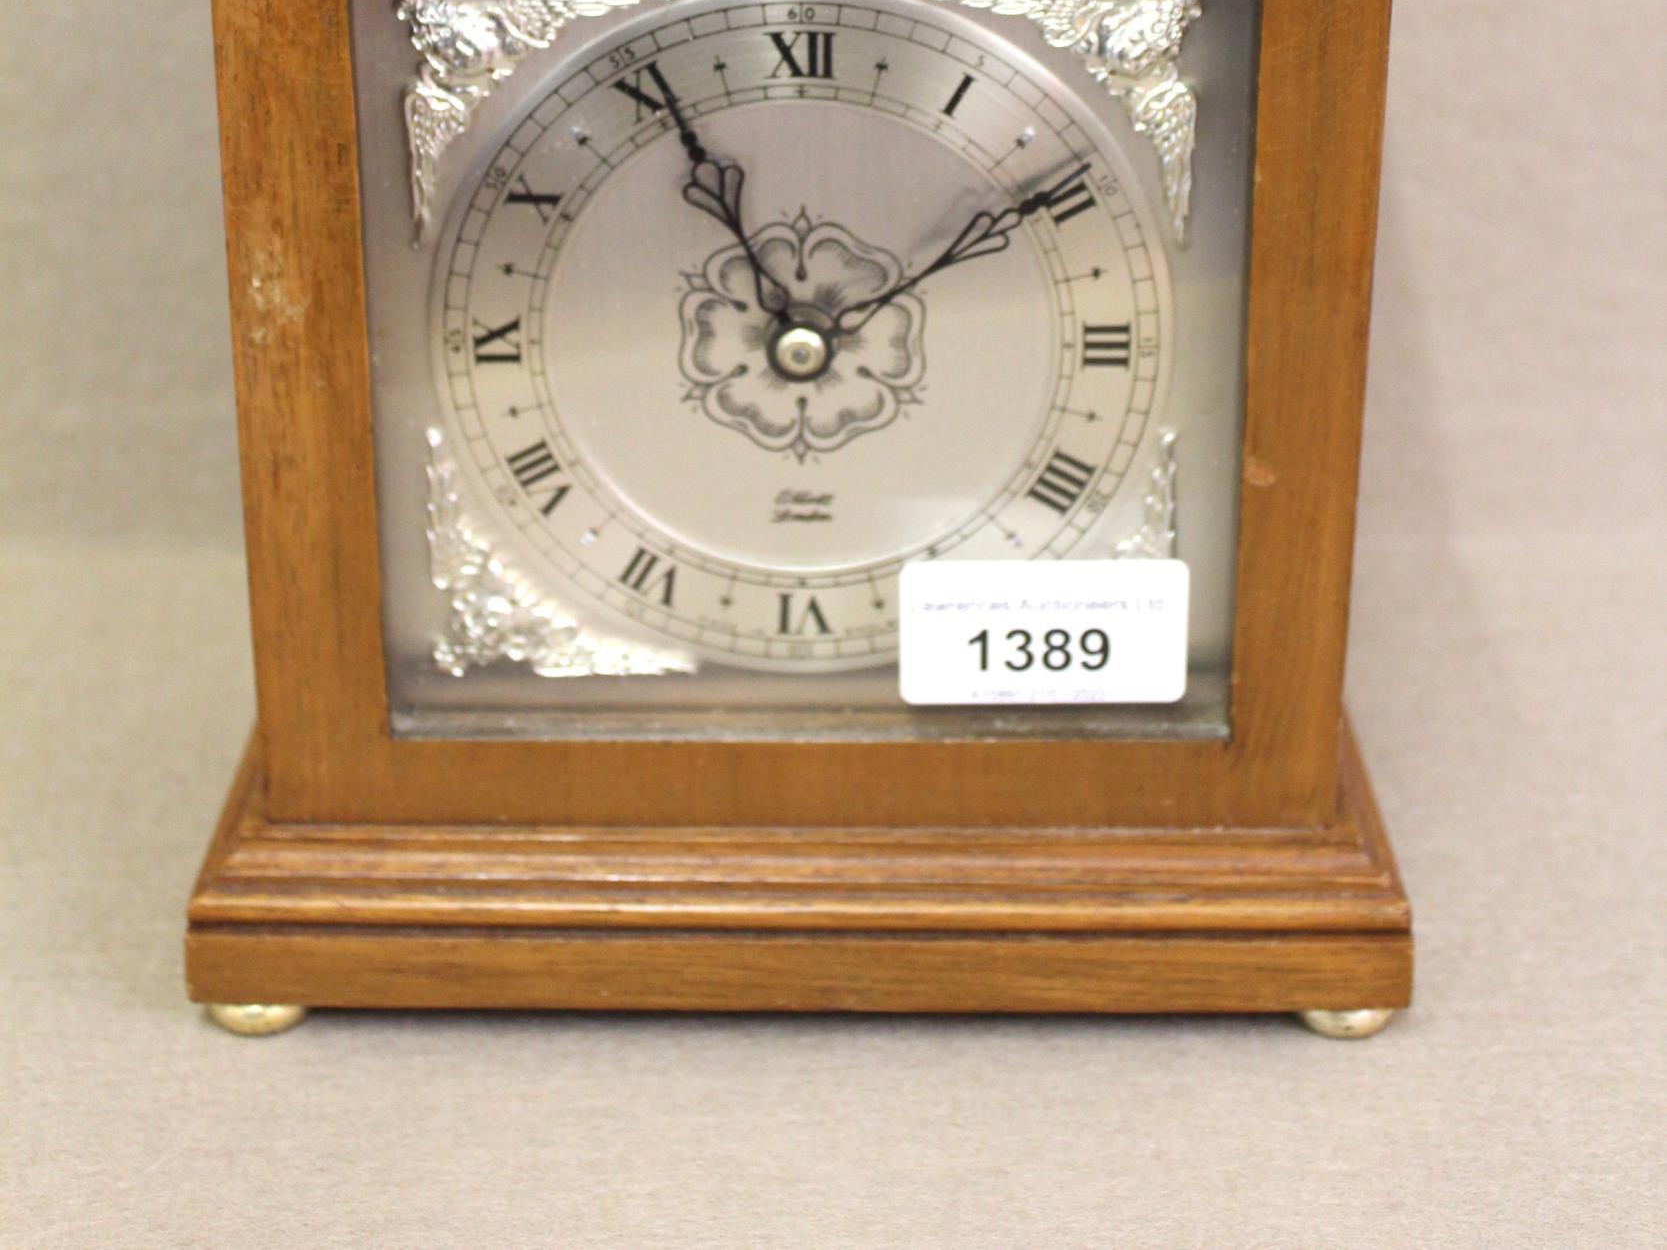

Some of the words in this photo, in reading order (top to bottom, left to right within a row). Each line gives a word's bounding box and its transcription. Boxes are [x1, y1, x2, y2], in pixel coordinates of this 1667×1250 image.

[787, 7, 814, 21] 60
[608, 46, 636, 69] 55
[764, 31, 837, 80] XII
[975, 53, 986, 69] 5
[942, 73, 976, 119] I
[503, 171, 564, 225] X
[1046, 178, 1098, 226] II
[471, 317, 522, 365] IX
[1082, 322, 1131, 370] III
[504, 439, 572, 517] VIII
[1027, 448, 1098, 516] IIII
[619, 548, 678, 607] VII
[777, 593, 834, 636] VI
[968, 628, 1111, 672] 1389
